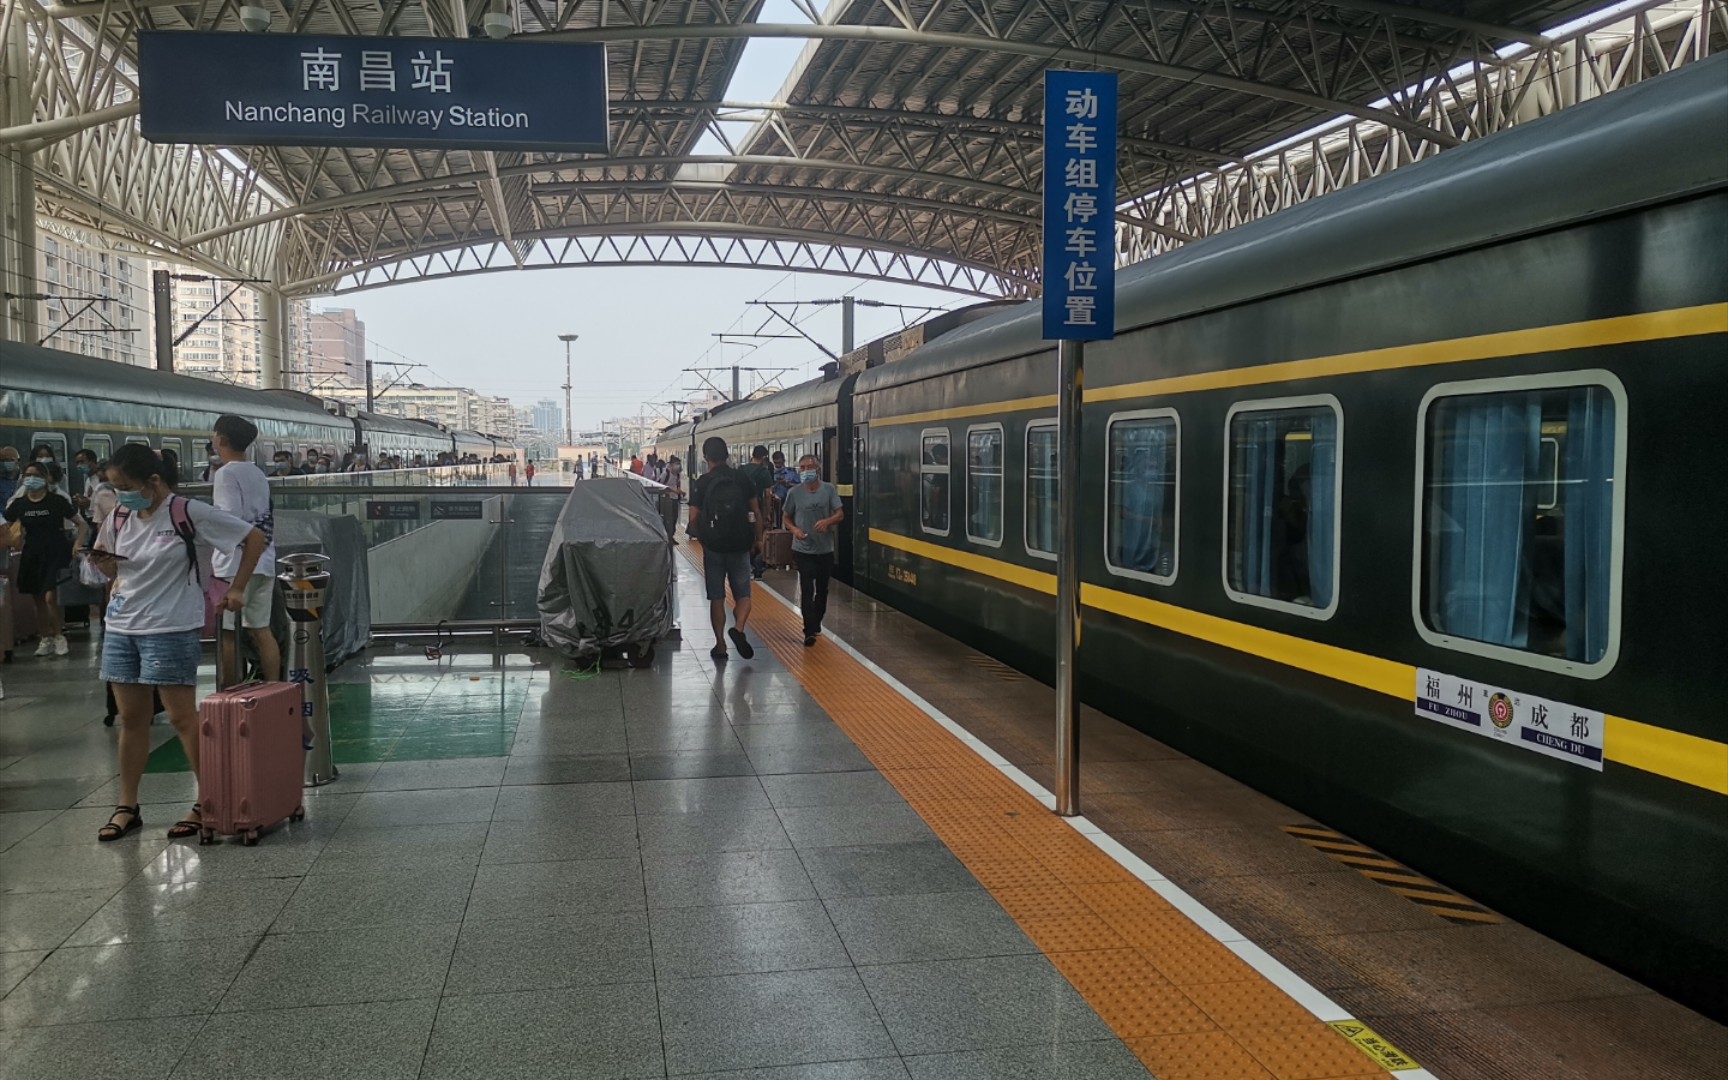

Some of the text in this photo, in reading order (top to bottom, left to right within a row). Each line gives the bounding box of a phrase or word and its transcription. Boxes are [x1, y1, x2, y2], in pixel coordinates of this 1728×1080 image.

[300, 46, 454, 93] 南昌站
[224, 100, 529, 131] Nanchang Railway Station
[1063, 87, 1099, 325] 动车组停车位置
[1425, 674, 1473, 709] 福州
[1428, 701, 1468, 720] FU ZHOU
[1530, 703, 1590, 740] 成都
[1536, 733, 1585, 755] CHENG DU
